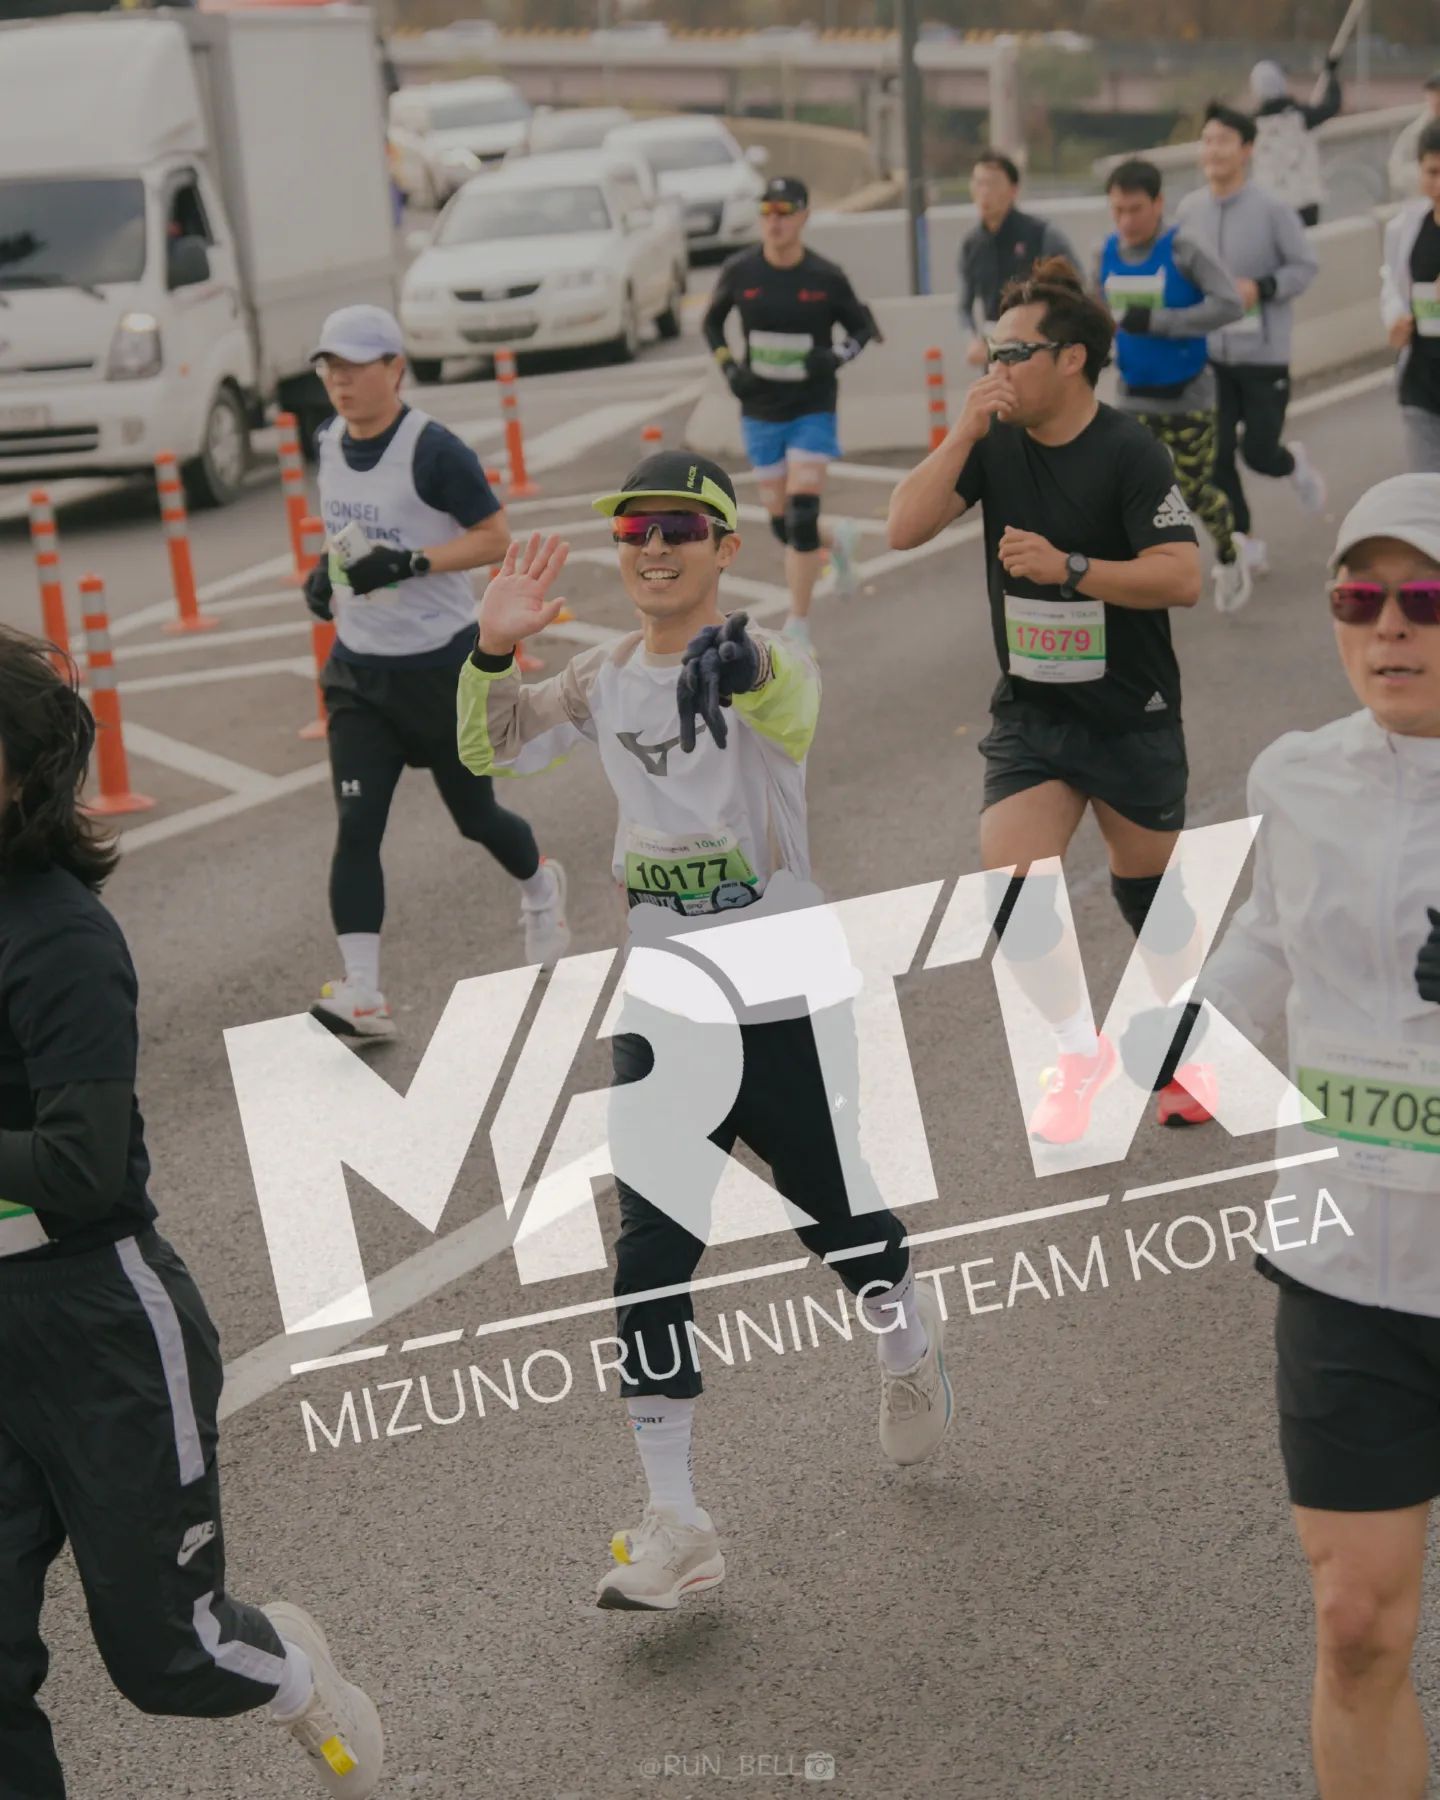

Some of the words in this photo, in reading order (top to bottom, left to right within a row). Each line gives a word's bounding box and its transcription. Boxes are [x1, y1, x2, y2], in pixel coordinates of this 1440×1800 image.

[1017, 625, 1092, 654] 17679
[637, 858, 728, 891] 10177
[1316, 1080, 1440, 1136] 11708
